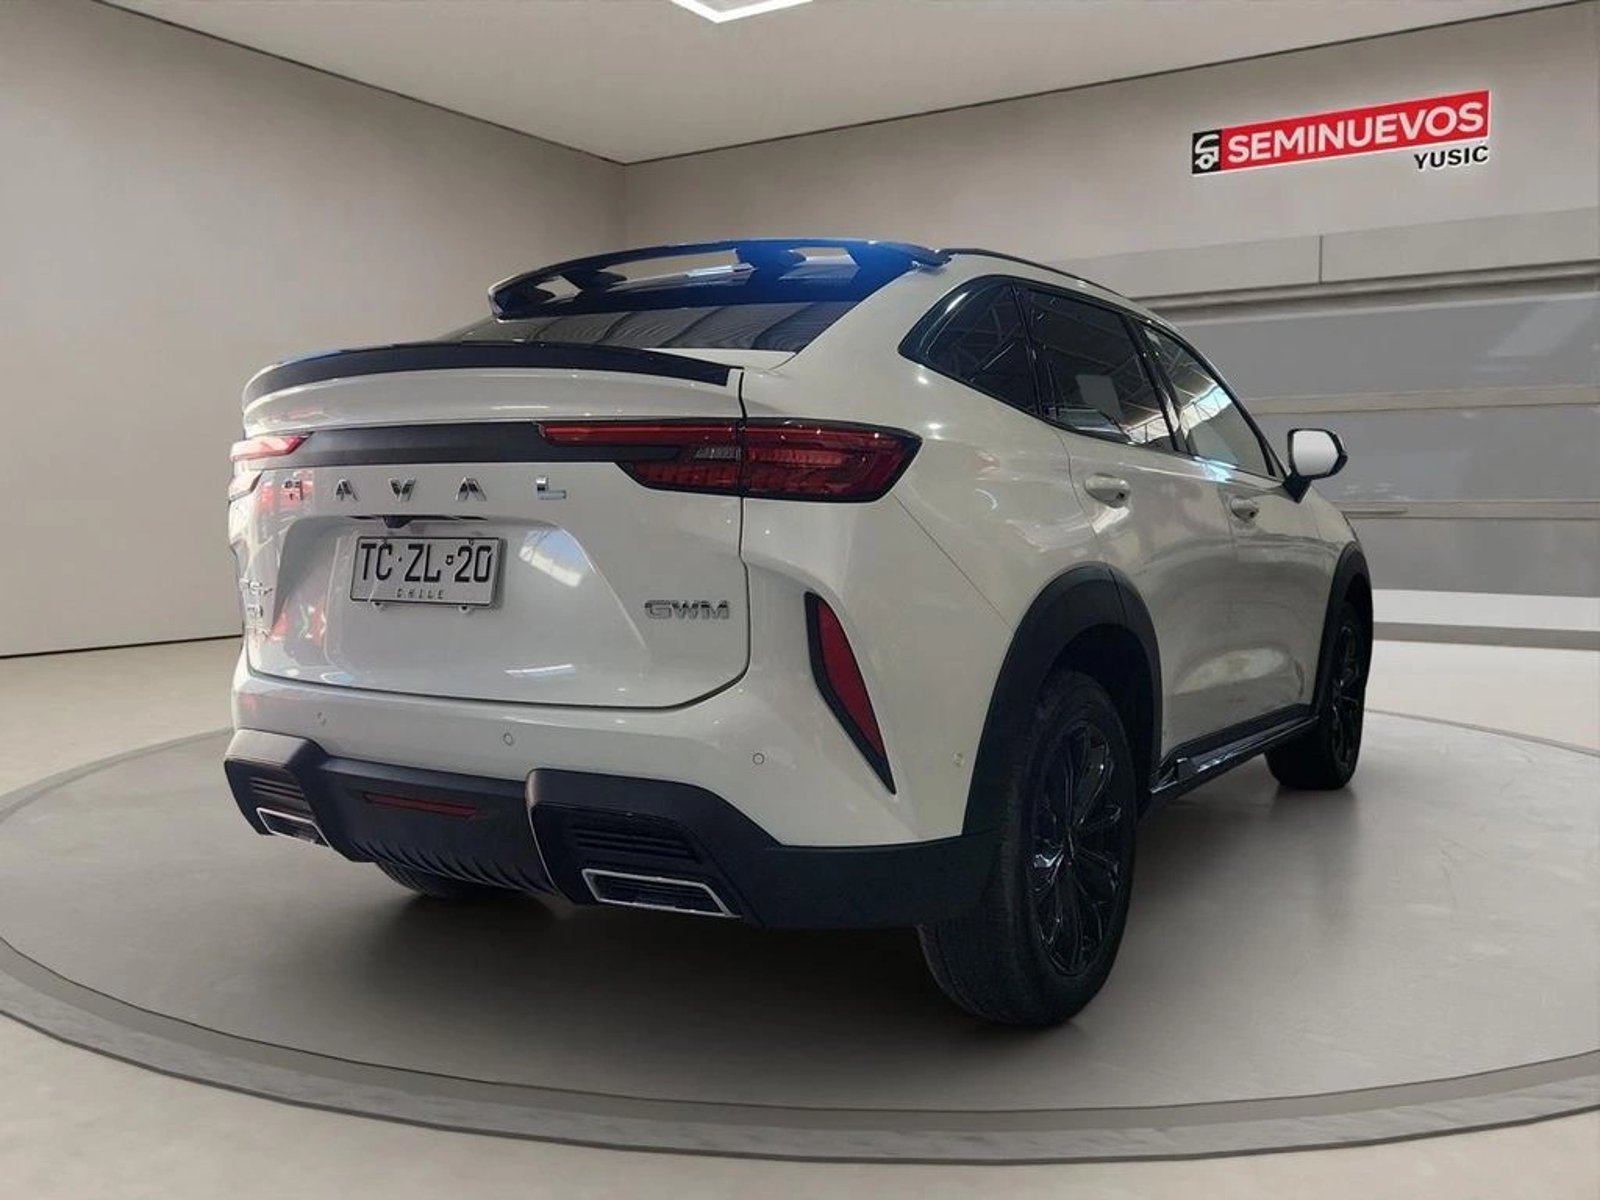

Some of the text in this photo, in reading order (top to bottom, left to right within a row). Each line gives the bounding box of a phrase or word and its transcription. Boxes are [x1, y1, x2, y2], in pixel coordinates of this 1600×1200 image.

[1228, 102, 1484, 163] SEMINUEVOS
[1414, 145, 1489, 169] YUSIC
[396, 587, 445, 600] CHILE
[644, 600, 730, 620] GWM
